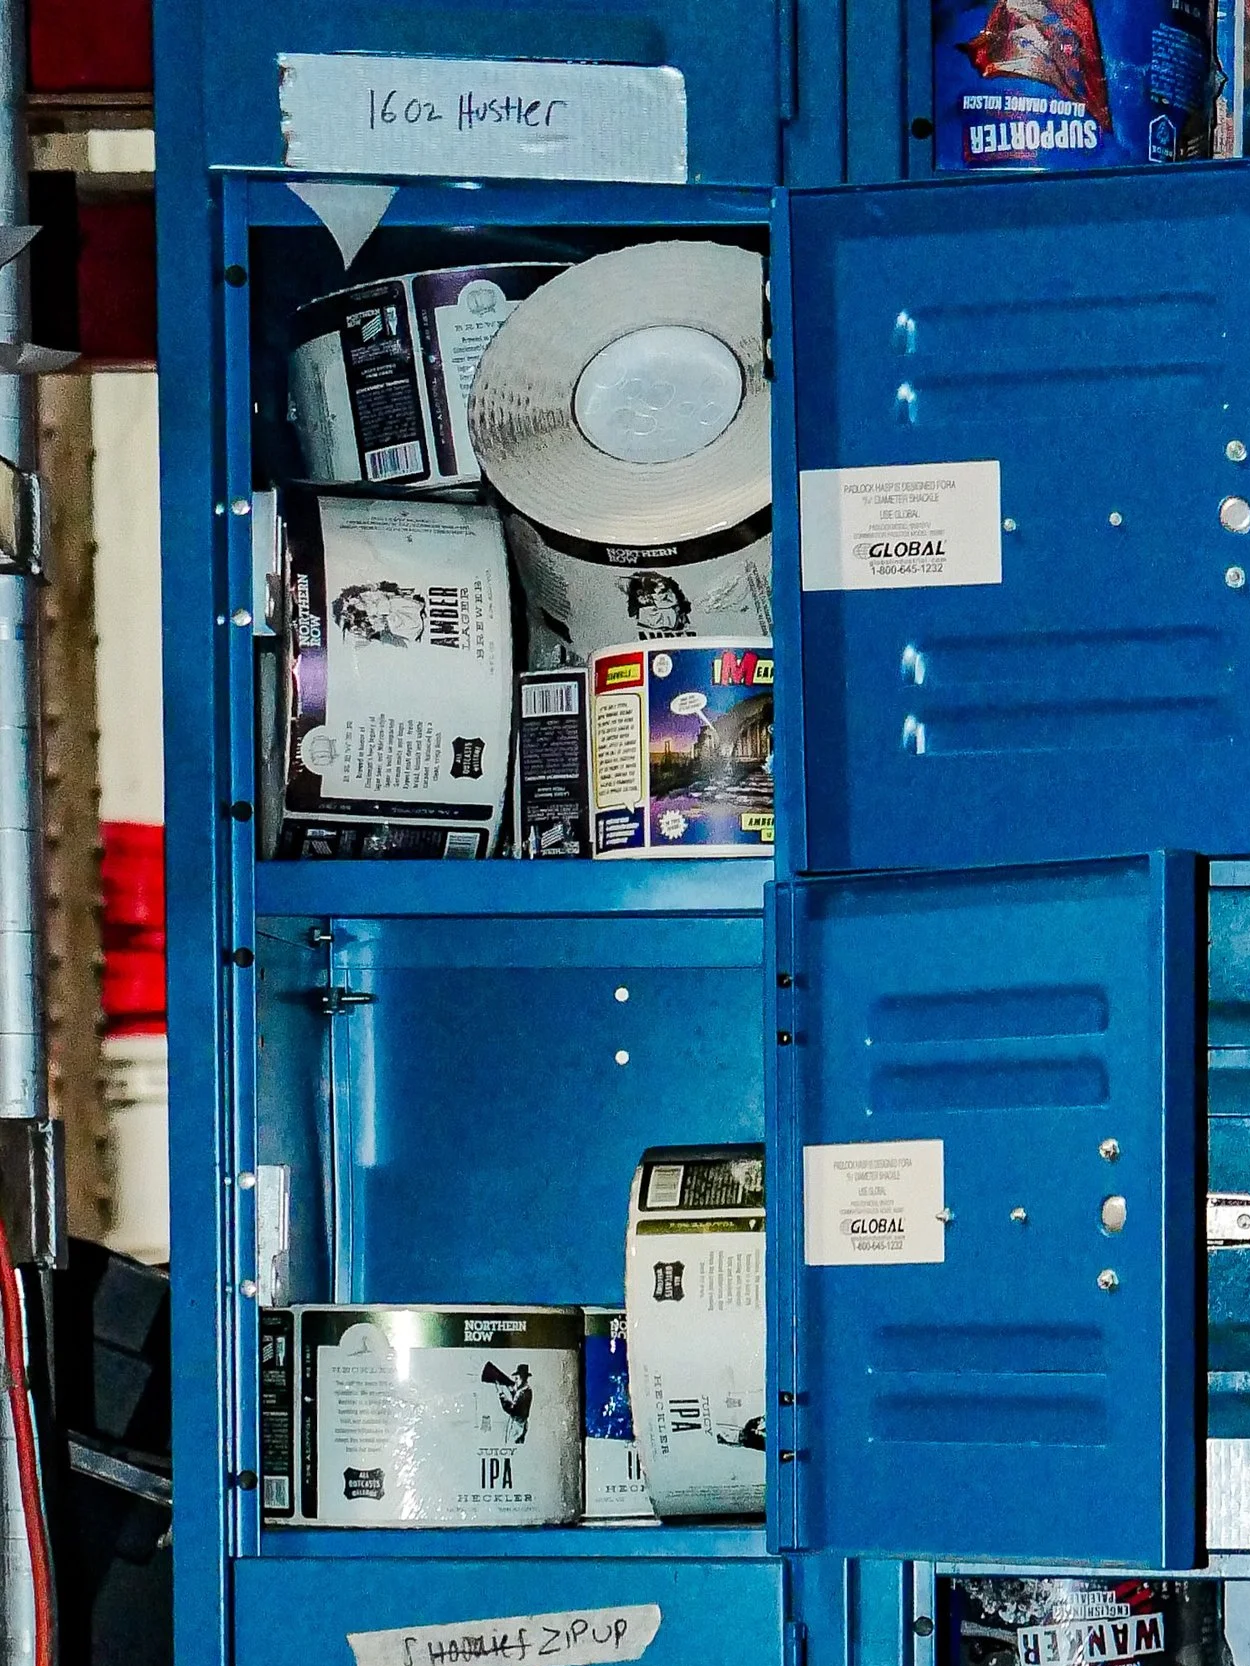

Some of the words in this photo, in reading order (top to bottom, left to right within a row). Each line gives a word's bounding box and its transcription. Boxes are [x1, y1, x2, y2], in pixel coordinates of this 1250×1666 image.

[458, 90, 568, 131] Hustler
[1004, 96, 1047, 113] ORANGE
[969, 119, 1098, 153] SUPPORTER
[606, 546, 678, 561] NORTHERN
[869, 541, 945, 557] GLOBAL
[872, 564, 943, 575] 1-800-645-1232
[298, 574, 310, 647] NORTHERN
[429, 586, 459, 648] AMBER
[460, 587, 470, 650] LAGER
[310, 615, 321, 647] ROW
[851, 1218, 904, 1233] GLOBAL
[464, 1319, 527, 1332] NORTHERN
[464, 1331, 494, 1342] ROW
[654, 1376, 670, 1455] HECKLER
[669, 1399, 702, 1433] IPA
[477, 1448, 518, 1457] JUICY
[481, 1458, 513, 1489] IPA
[457, 1493, 533, 1503] HECKLER
[1022, 1618, 1162, 1665] WANKER
